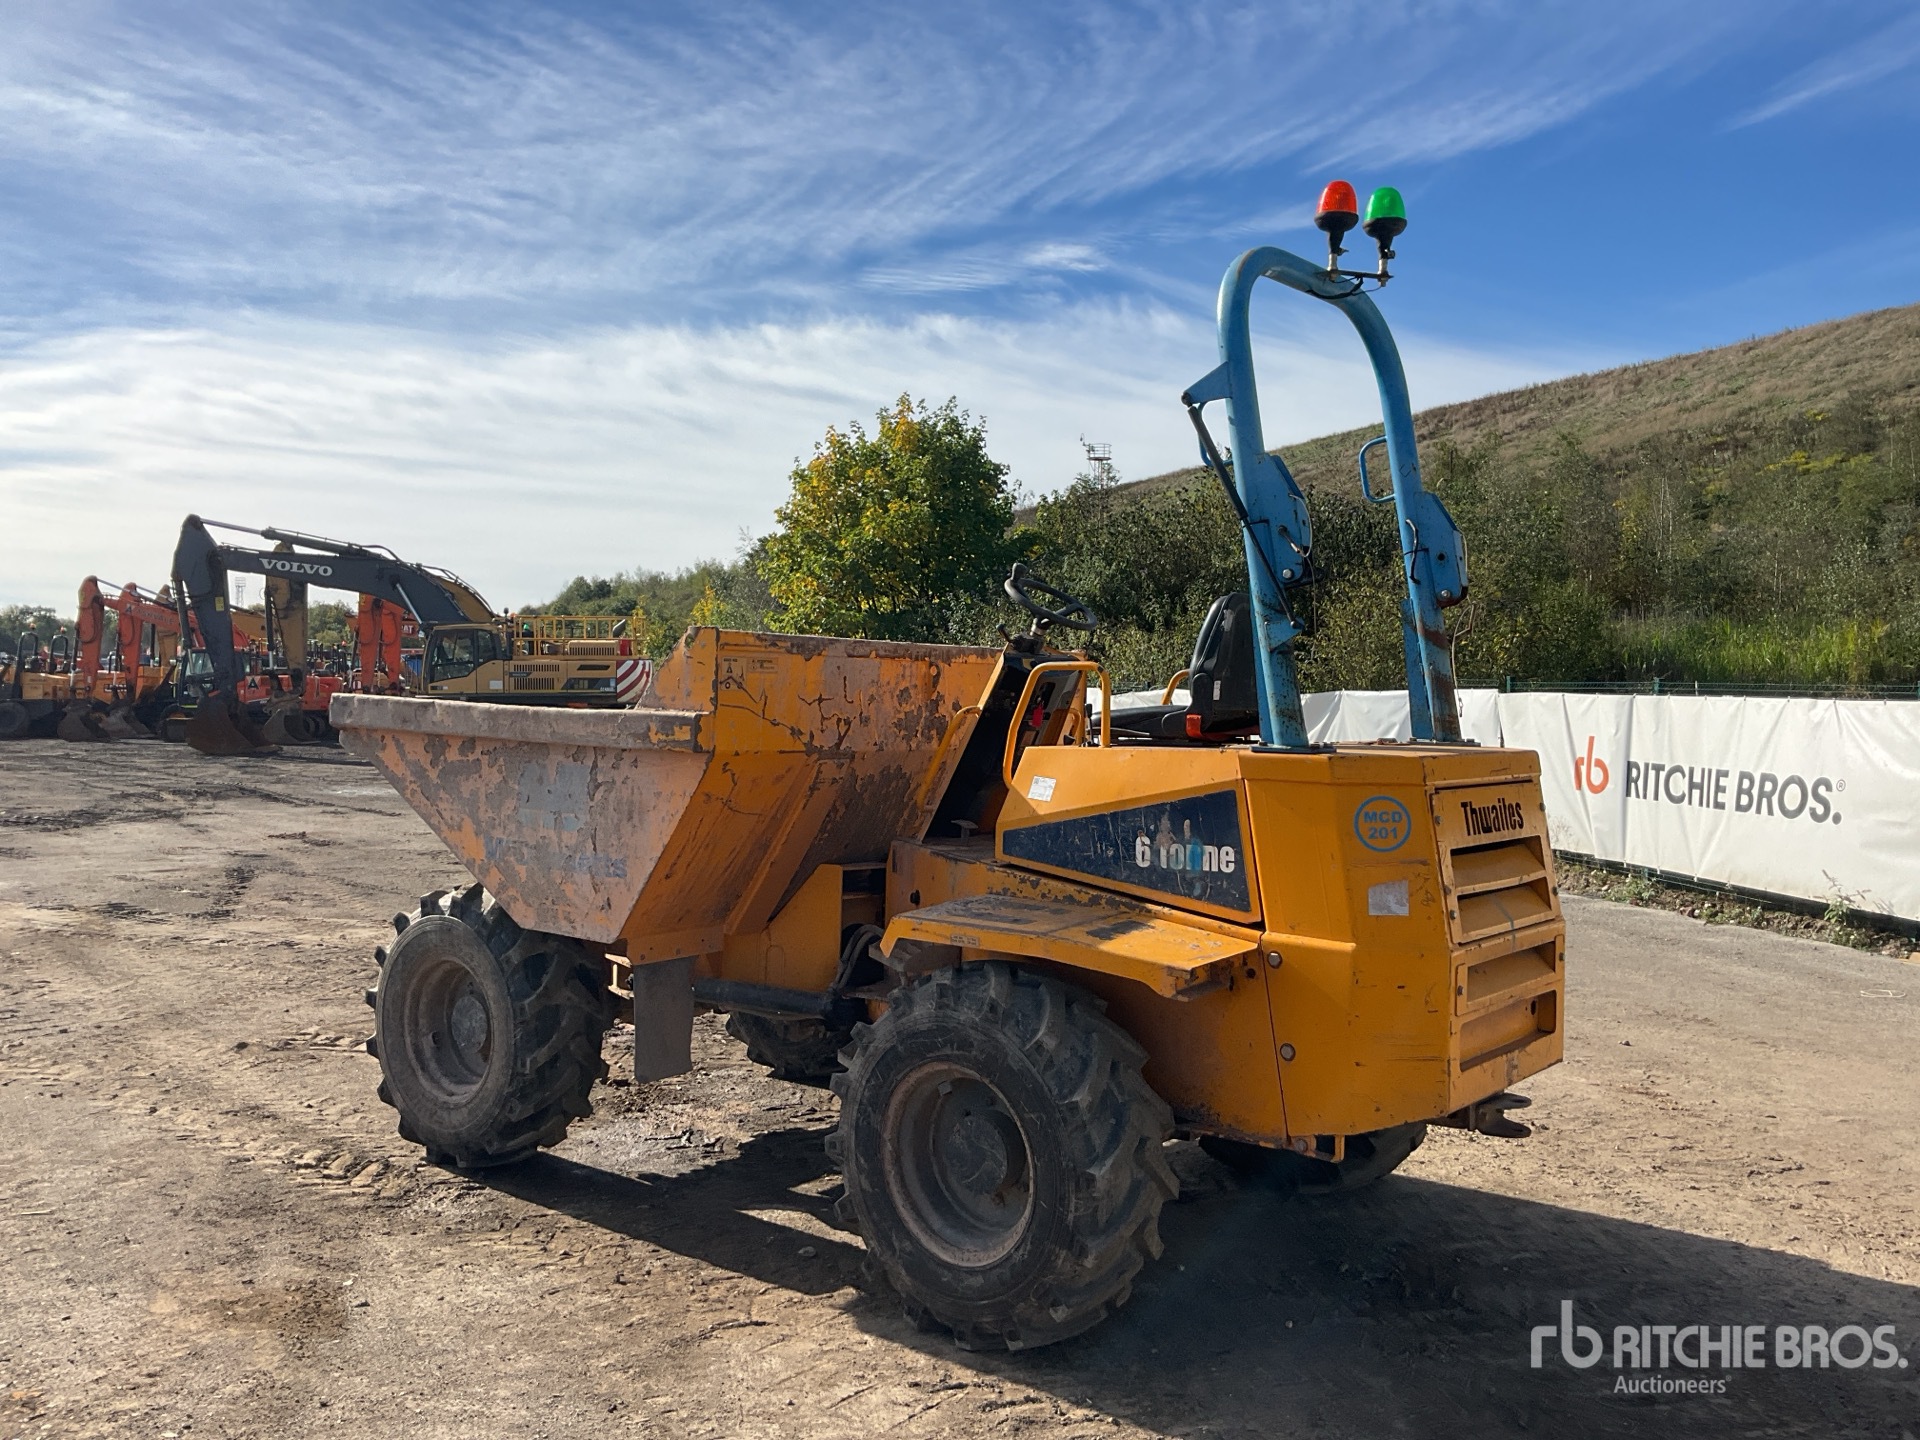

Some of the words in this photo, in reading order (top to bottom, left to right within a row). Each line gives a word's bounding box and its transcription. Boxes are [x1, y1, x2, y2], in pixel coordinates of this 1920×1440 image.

[259, 558, 333, 577] VOLVO
[400, 624, 414, 635] AT
[1625, 760, 1730, 811] RITCHIE
[1363, 810, 1403, 824] MCD
[1460, 797, 1525, 837] Thwaites
[1368, 826, 1398, 840] 201
[1135, 835, 1151, 868] 6
